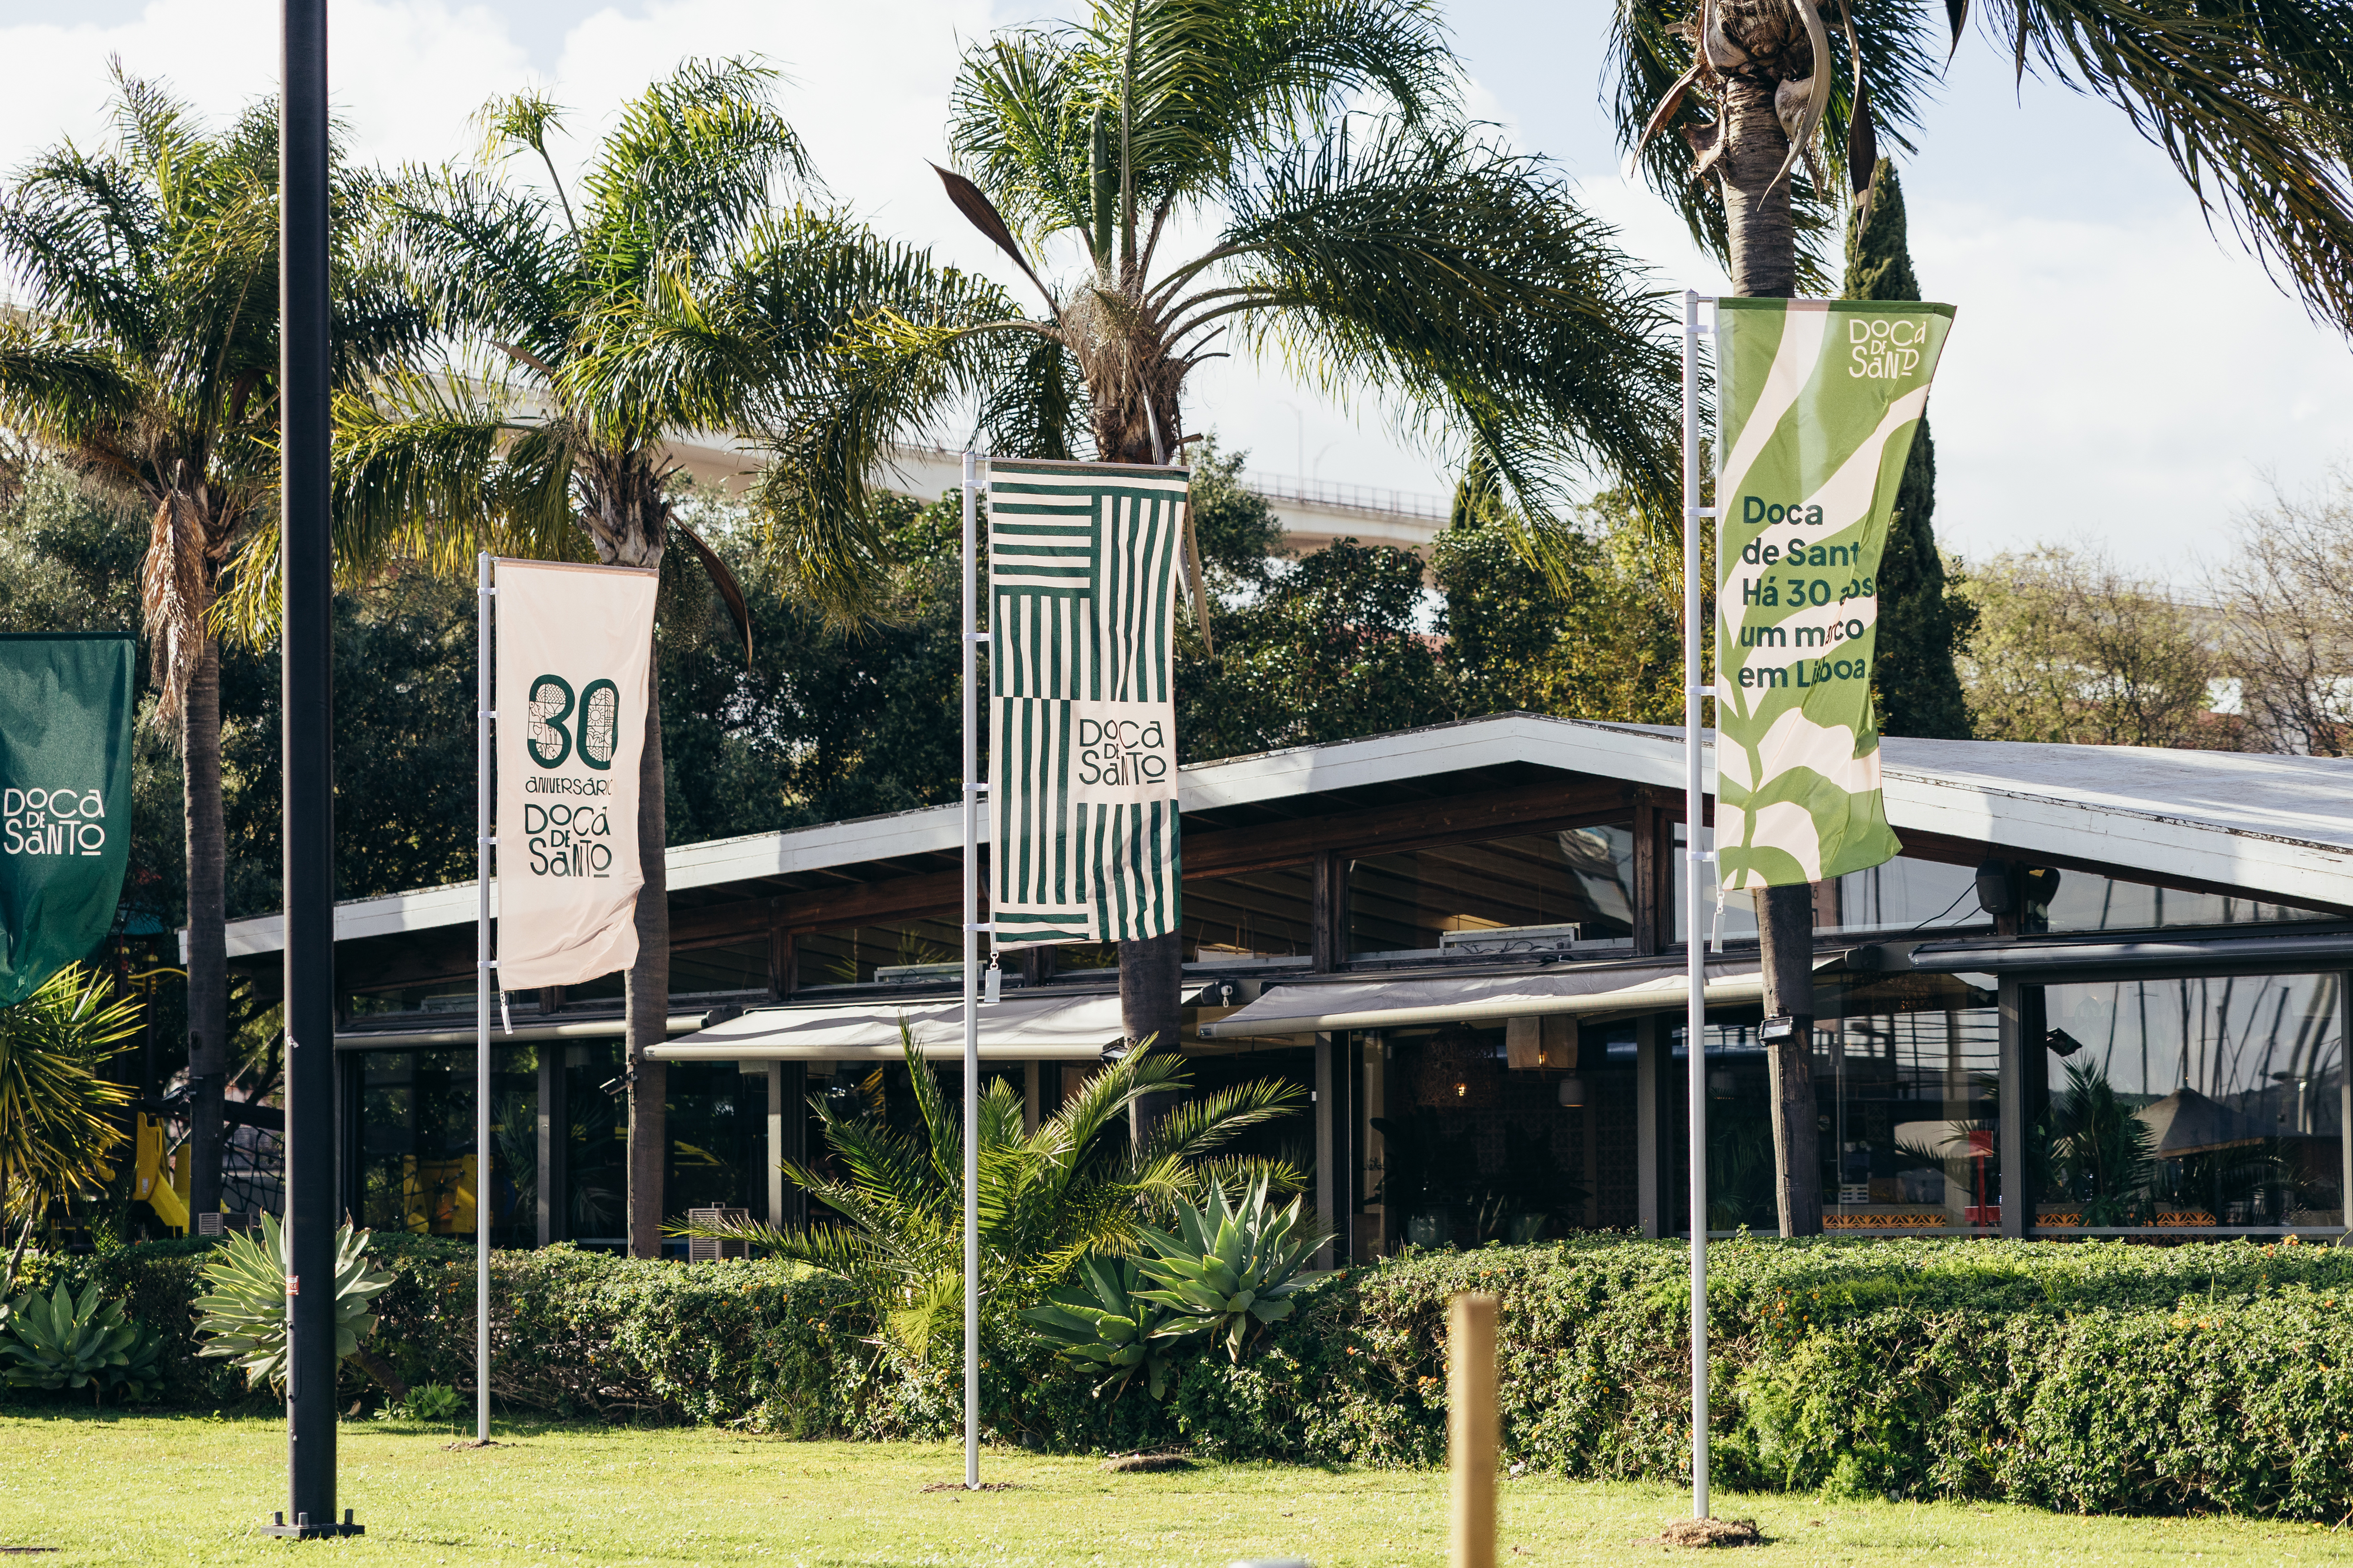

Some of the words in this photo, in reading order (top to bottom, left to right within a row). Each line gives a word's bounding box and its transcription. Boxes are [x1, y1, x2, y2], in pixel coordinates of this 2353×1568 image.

[1871, 340, 1887, 355] DE
[1743, 496, 1824, 525] Doca
[1742, 537, 1779, 566] de
[1743, 576, 1778, 606] Há
[1786, 579, 1831, 607] 30
[1741, 626, 1787, 648] um
[1738, 667, 1788, 688] em
[527, 674, 619, 770] 30
[1104, 743, 1119, 759] DE
[26, 811, 45, 828] DE
[551, 830, 570, 848] DE
